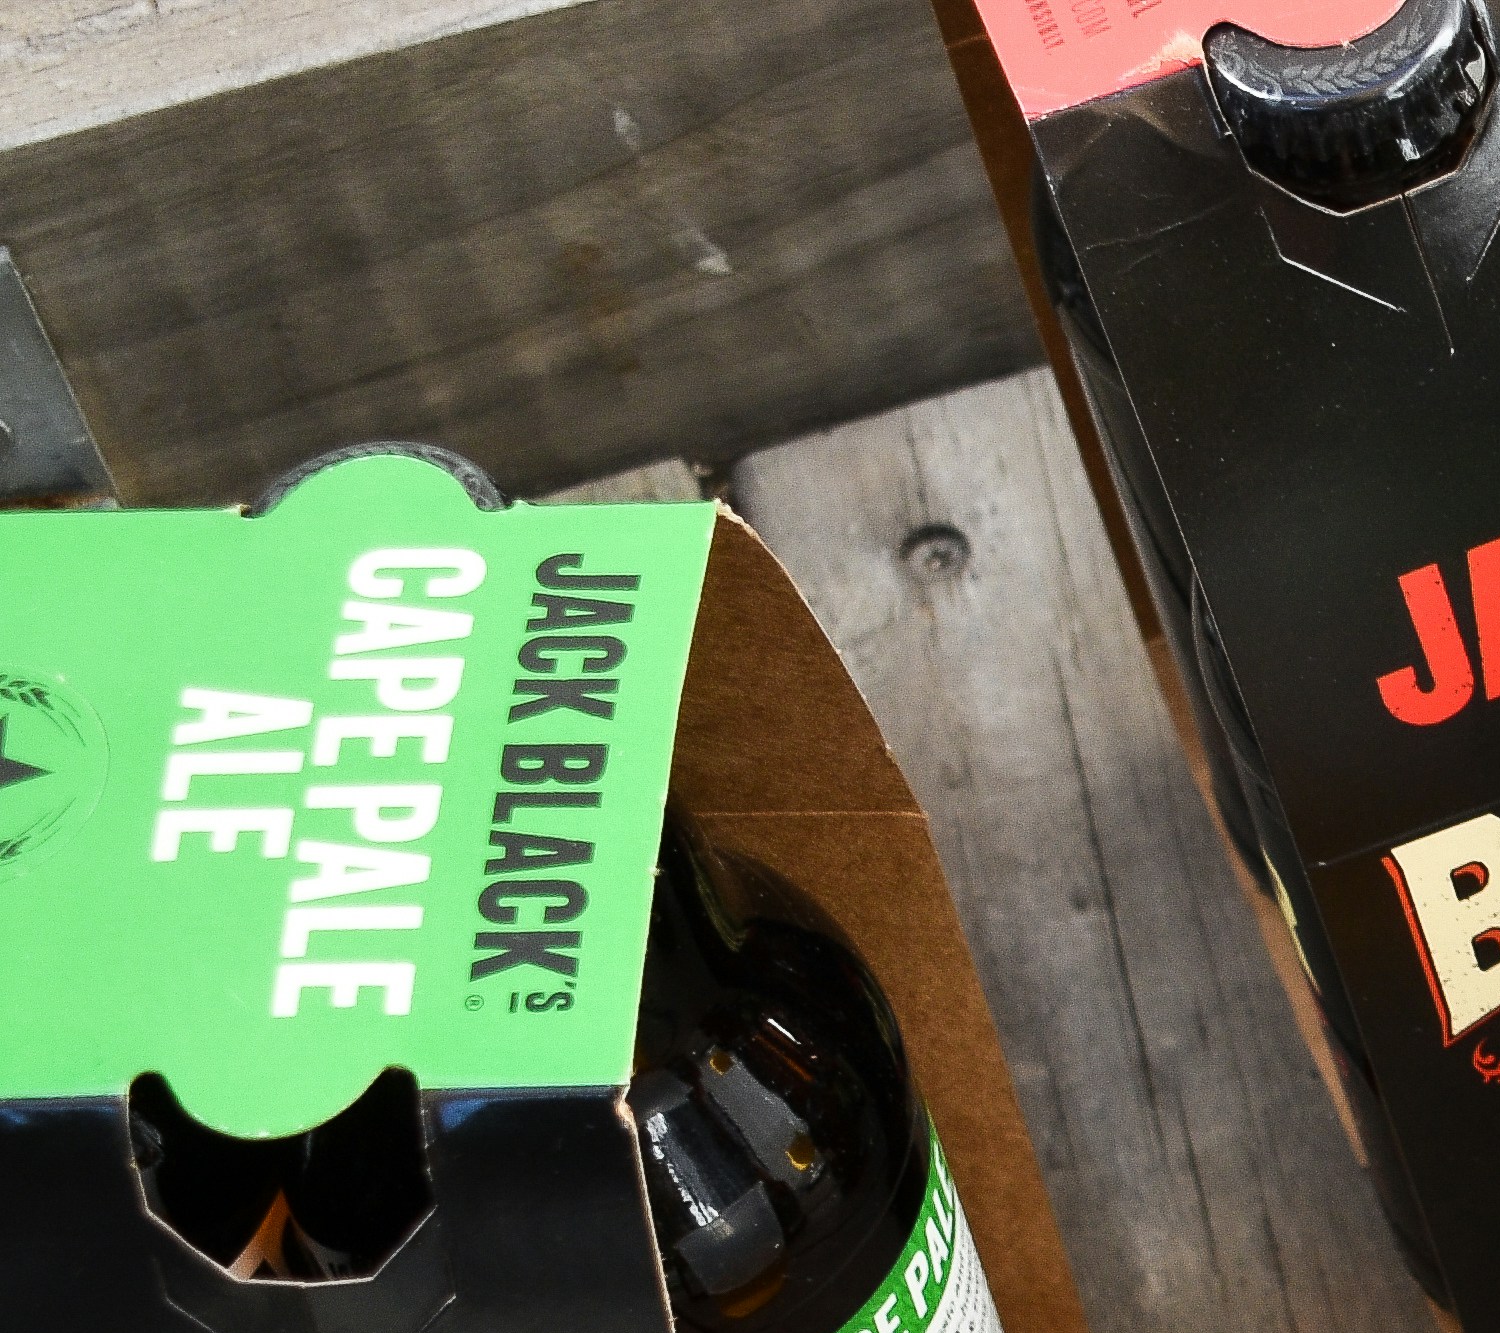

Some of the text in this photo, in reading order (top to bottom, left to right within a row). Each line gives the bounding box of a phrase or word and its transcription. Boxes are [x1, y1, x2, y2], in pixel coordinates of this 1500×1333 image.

[150, 686, 315, 864] ALE
[269, 544, 488, 1020] CAPE PALE
[468, 551, 642, 1015] JACK BLACK'S
